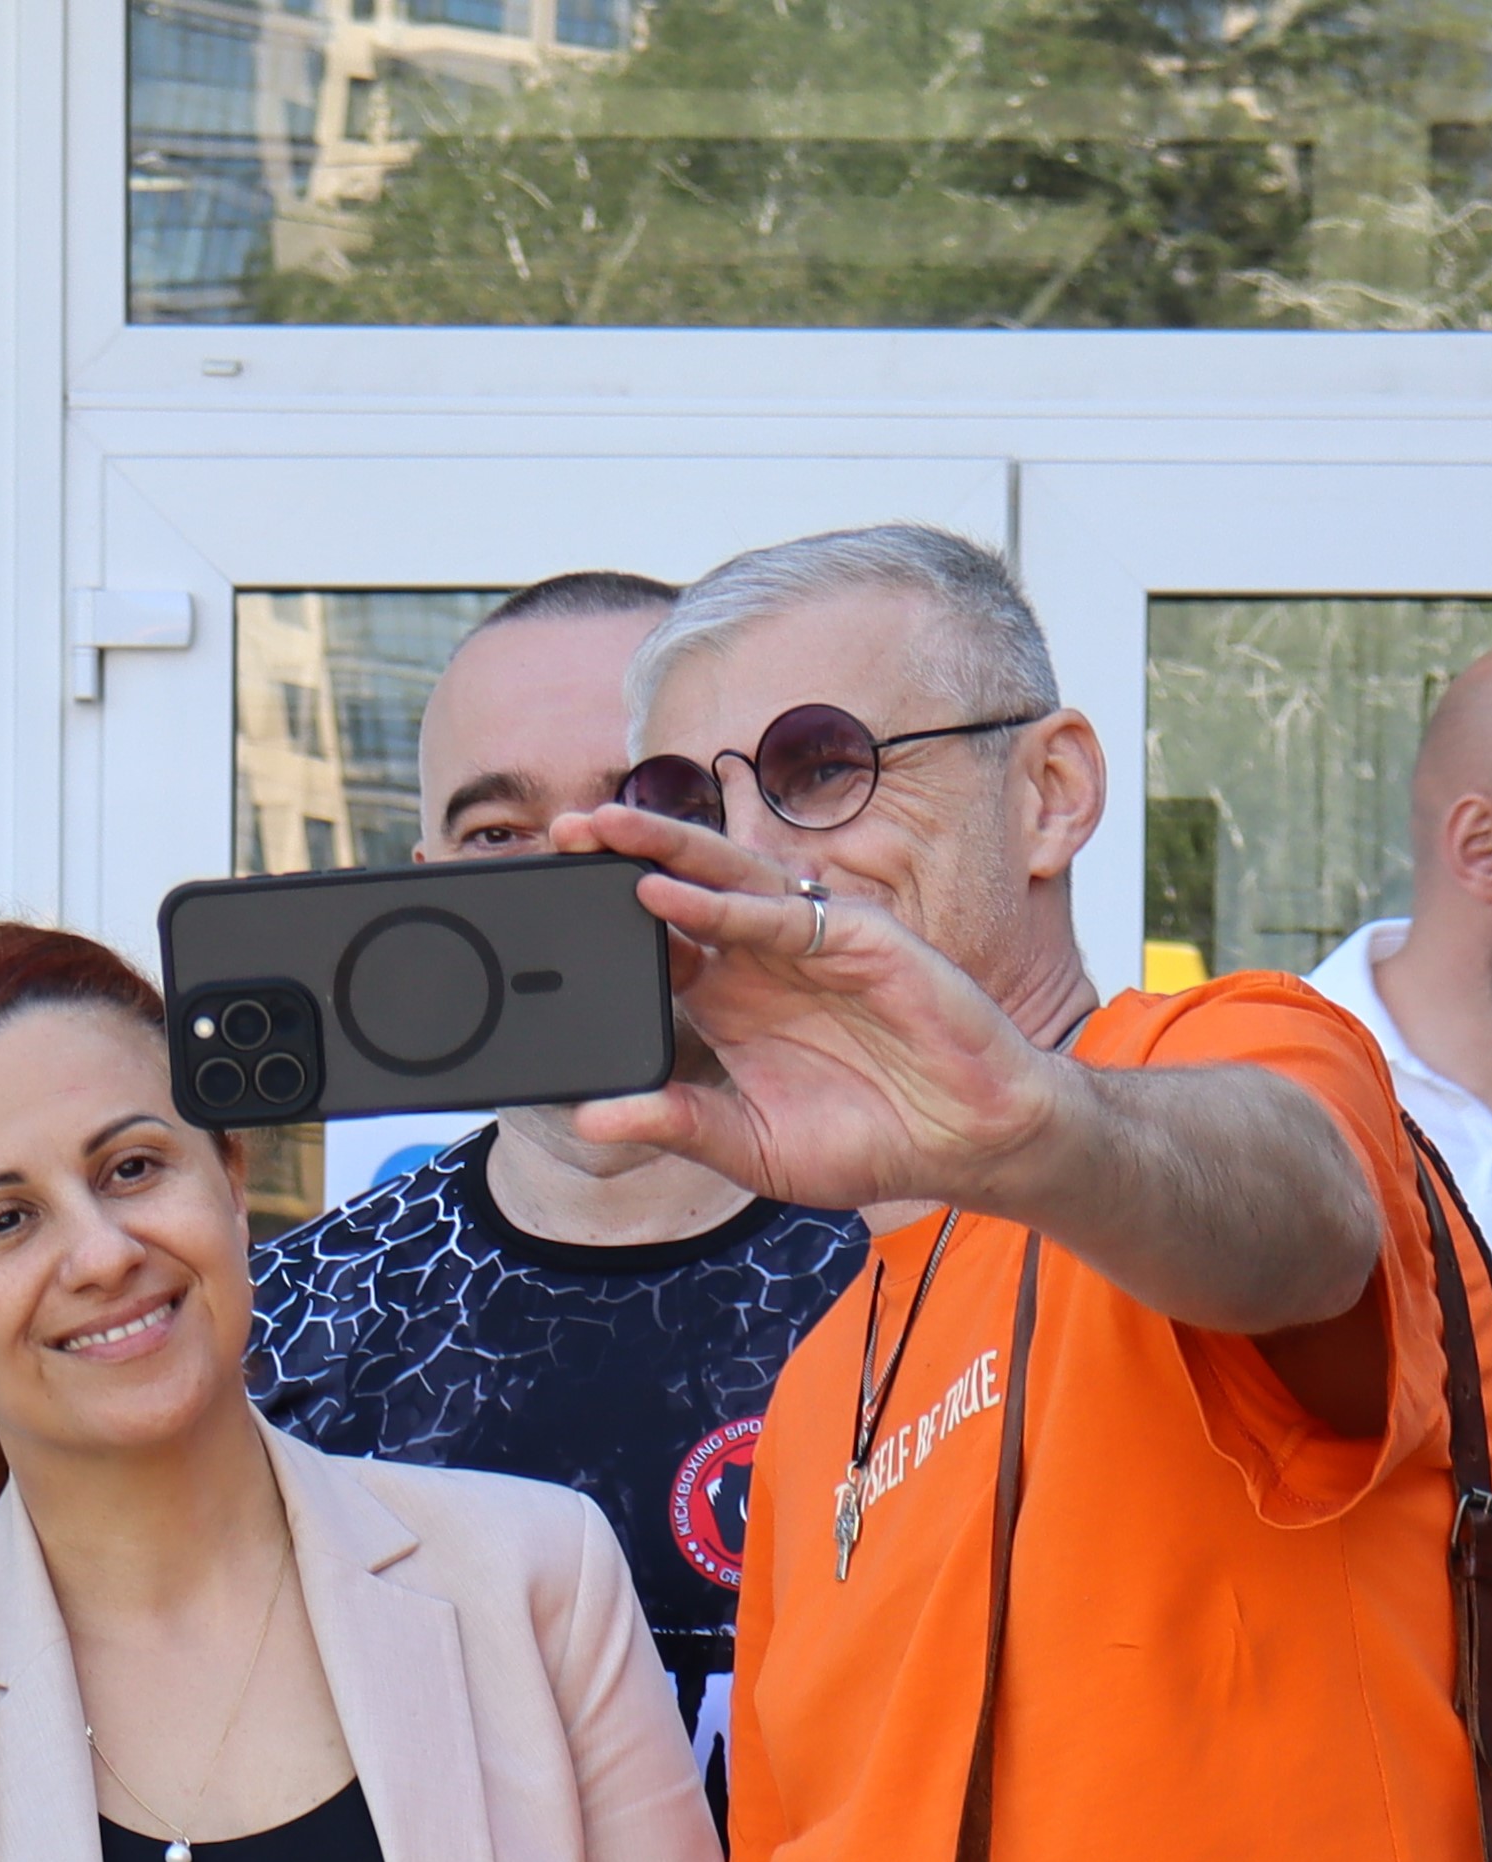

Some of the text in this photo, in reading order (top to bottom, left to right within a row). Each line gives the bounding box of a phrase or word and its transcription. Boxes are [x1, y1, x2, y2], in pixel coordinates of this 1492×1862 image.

[674, 1419, 763, 1537] KICKBOXING SPO
[835, 1350, 1001, 1517] TYSELF BE TRUE
[719, 1568, 742, 1586] GE
